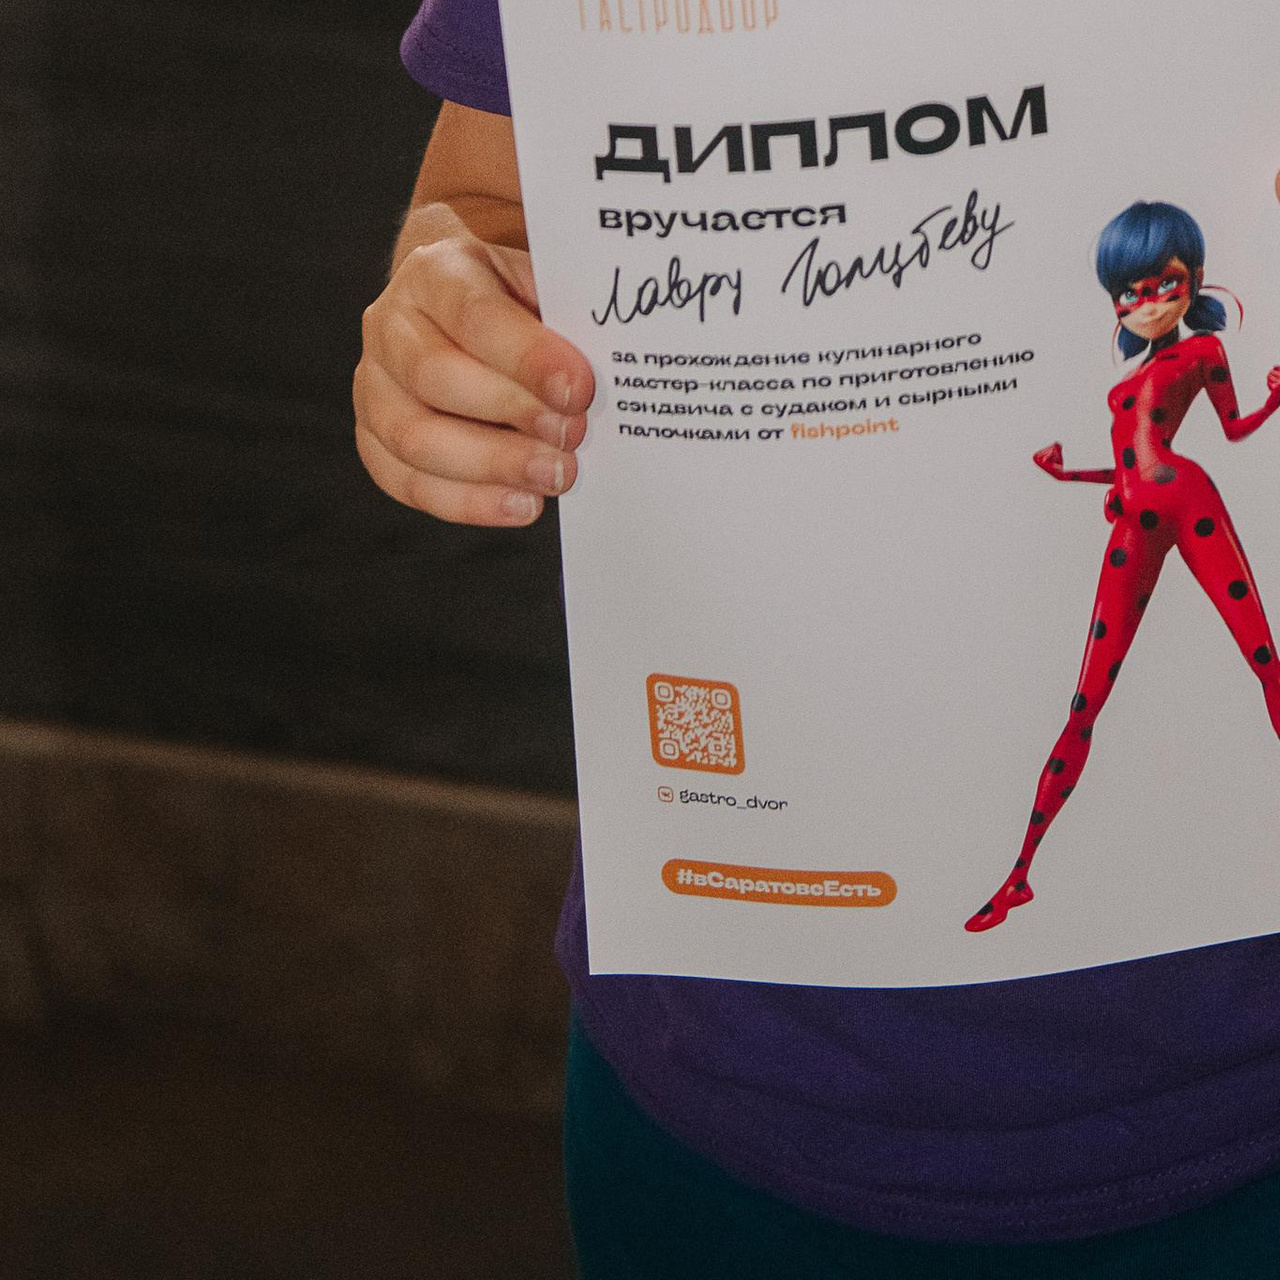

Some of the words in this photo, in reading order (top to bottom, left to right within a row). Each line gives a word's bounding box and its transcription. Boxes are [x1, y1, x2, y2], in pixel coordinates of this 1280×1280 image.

[595, 83, 1048, 183] ДИПЛОМ
[599, 203, 847, 238] вручается
[592, 256, 743, 326] Лавру
[612, 351, 638, 364] за
[644, 351, 810, 368] прохождение
[818, 333, 982, 366] кулинарного
[614, 375, 795, 393] мастер-класса
[802, 376, 832, 388] по
[839, 349, 1035, 388] приготовлению
[617, 400, 733, 417] сэндвича
[741, 404, 754, 415] с
[761, 397, 867, 418] судаком
[875, 396, 891, 408] и
[898, 377, 1018, 404] сырными
[619, 423, 750, 440] палочками
[758, 427, 784, 440] от
[791, 416, 900, 440] fishpoint
[679, 788, 788, 810] gastro_dvor
[676, 868, 881, 898] #вСаратовеЕсть
